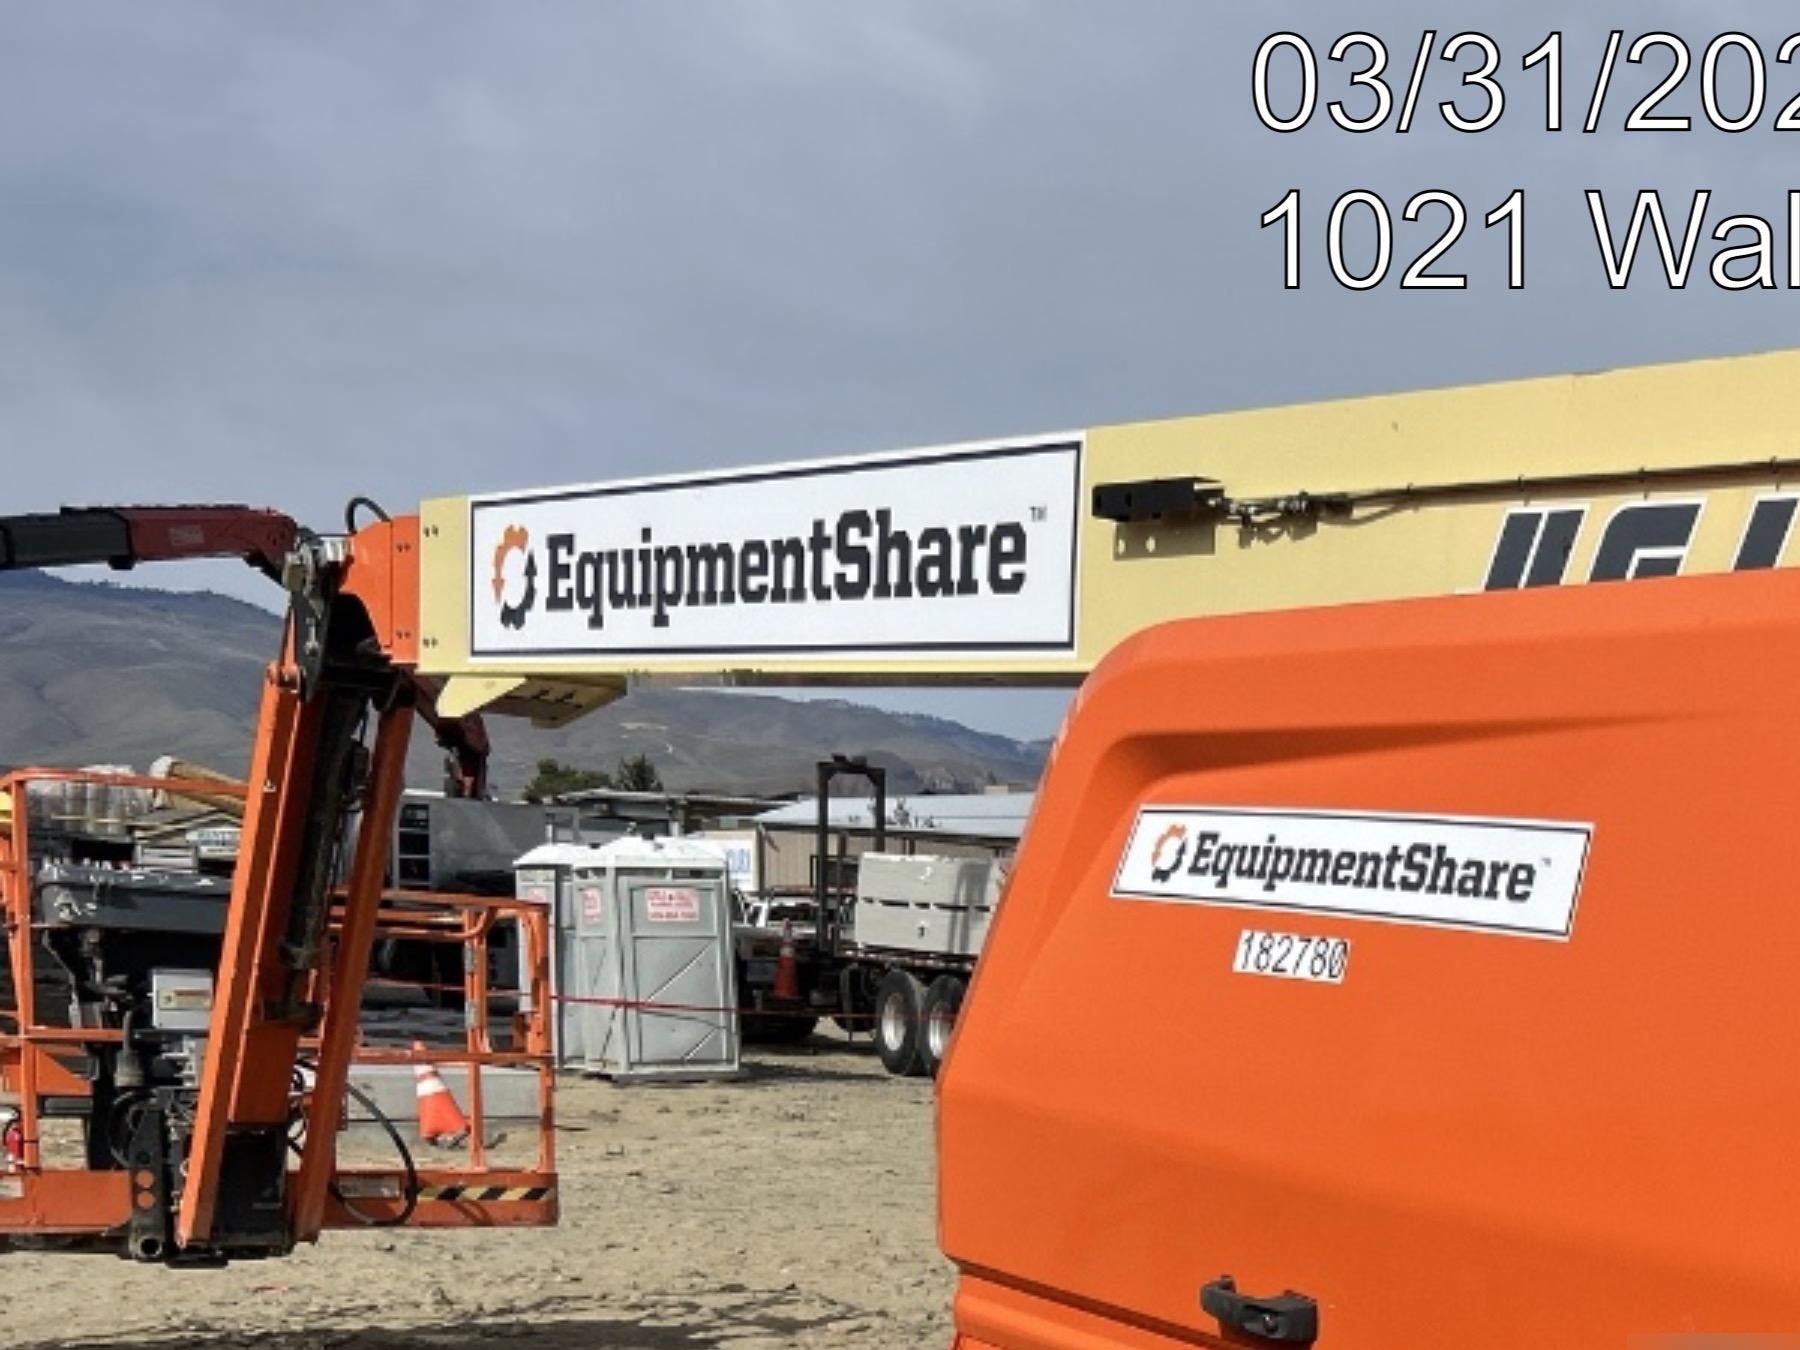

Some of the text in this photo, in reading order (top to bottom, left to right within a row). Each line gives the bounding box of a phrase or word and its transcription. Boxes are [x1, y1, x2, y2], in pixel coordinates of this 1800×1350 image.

[545, 508, 1028, 629] EquipmentShare
[1187, 830, 1537, 904] EquipmentShare
[1239, 930, 1349, 981] 182780
